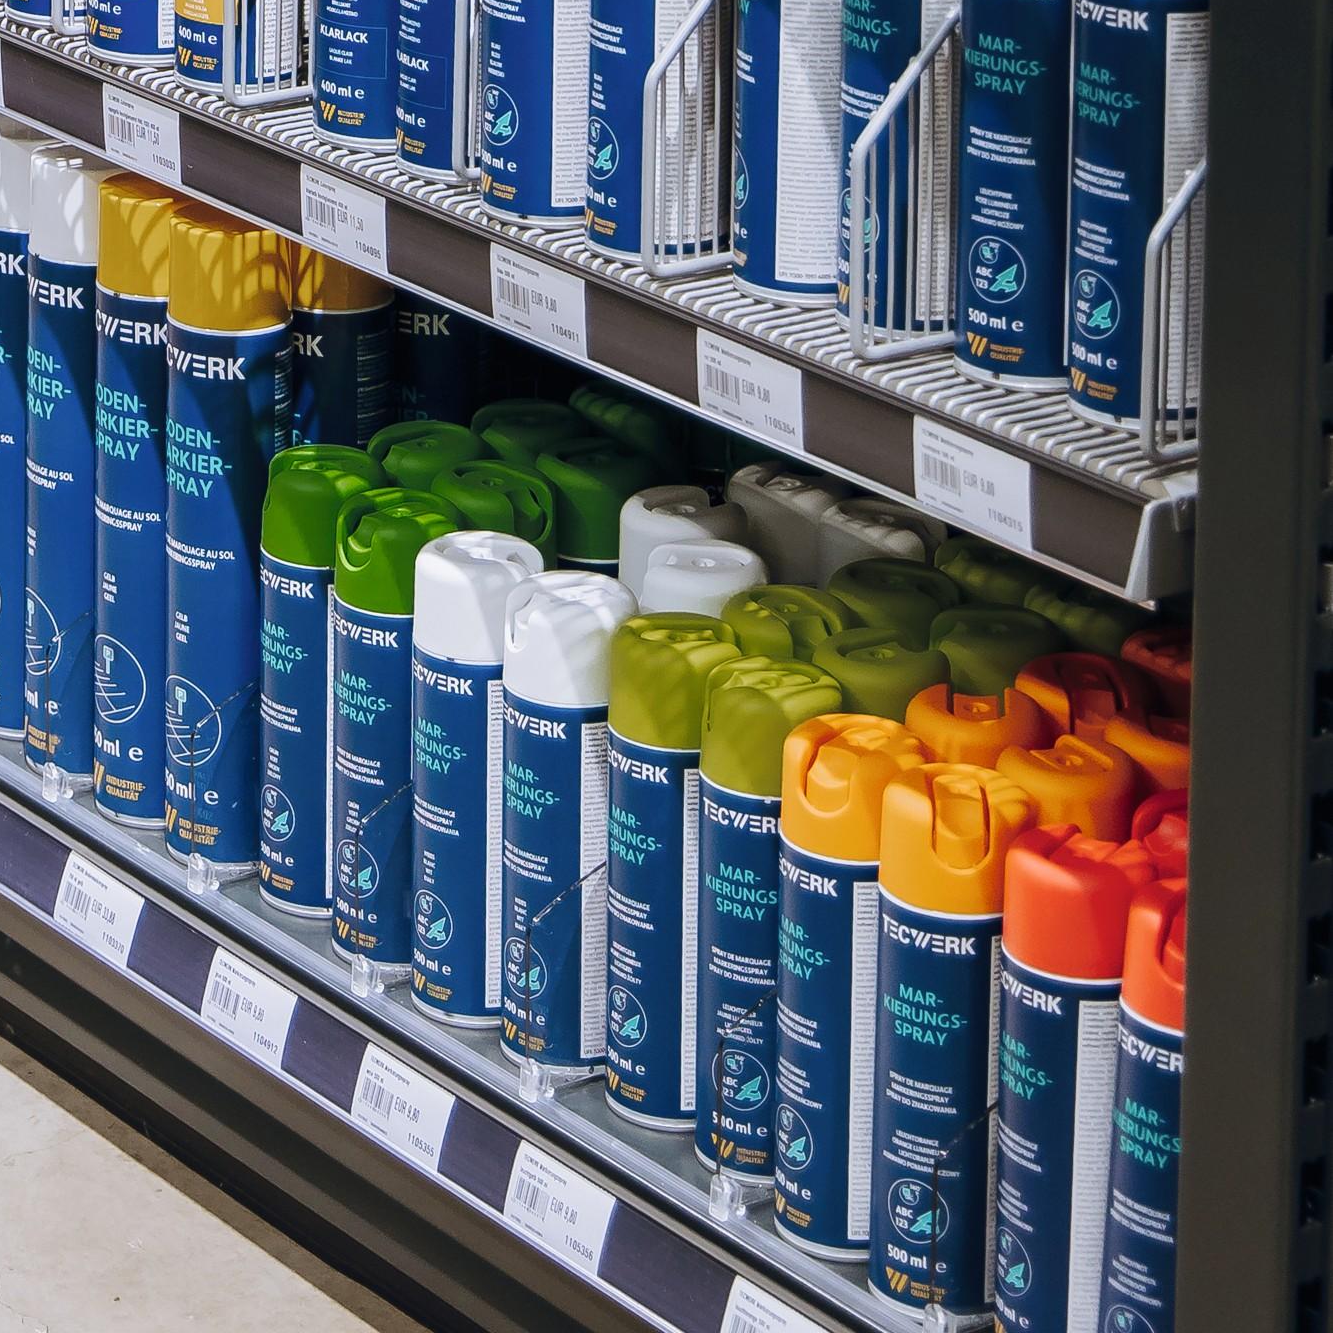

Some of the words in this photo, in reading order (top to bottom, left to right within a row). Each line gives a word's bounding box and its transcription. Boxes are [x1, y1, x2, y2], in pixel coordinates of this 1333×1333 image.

[179, 26, 194, 40] 400
[195, 29, 205, 43] ml
[320, 24, 368, 43] KLARLACK
[979, 34, 1021, 53] MAR-
[965, 47, 1045, 75] KIERUNGS-
[321, 80, 336, 94] 400
[338, 86, 351, 97] ml
[975, 72, 1025, 94] SPRAY
[136, 125, 146, 140] EUR
[148, 130, 159, 145] 11,50
[337, 209, 348, 224] EUR
[350, 215, 363, 232] 11,50
[976, 266, 992, 278] ABC
[976, 278, 988, 289] 123
[531, 290, 543, 307] EUR
[969, 308, 987, 325] 500
[990, 312, 1006, 329] ml
[551, 324, 578, 342] 1104911
[742, 379, 755, 397] EUR
[765, 415, 795, 436] 1105354
[219, 551, 235, 559] SOL
[341, 669, 371, 691] MAR-
[339, 701, 375, 725] SPRAY
[509, 760, 538, 783] MAR-
[507, 790, 544, 819] SPRAY
[720, 863, 760, 884] MAR-
[716, 897, 765, 921] SPRAY
[883, 913, 975, 954] TECWERK
[735, 955, 771, 966] MARQUAGE
[241, 997, 252, 1013] EUR
[900, 984, 943, 1007] MAR-
[884, 997, 966, 1028] KIERUNGS-
[254, 1032, 278, 1054] 1104912
[895, 1020, 946, 1045] SPRAY
[907, 1077, 914, 1086] DE
[915, 1079, 952, 1094] MARQUAGE
[394, 1097, 407, 1114] EUR
[408, 1133, 434, 1157] 1105355
[550, 1197, 564, 1216] EUR
[896, 1205, 913, 1218] ABC
[896, 1217, 908, 1228] 123
[566, 1235, 593, 1261] 1105356
[888, 1244, 908, 1266] 500
[910, 1250, 927, 1269] ml
